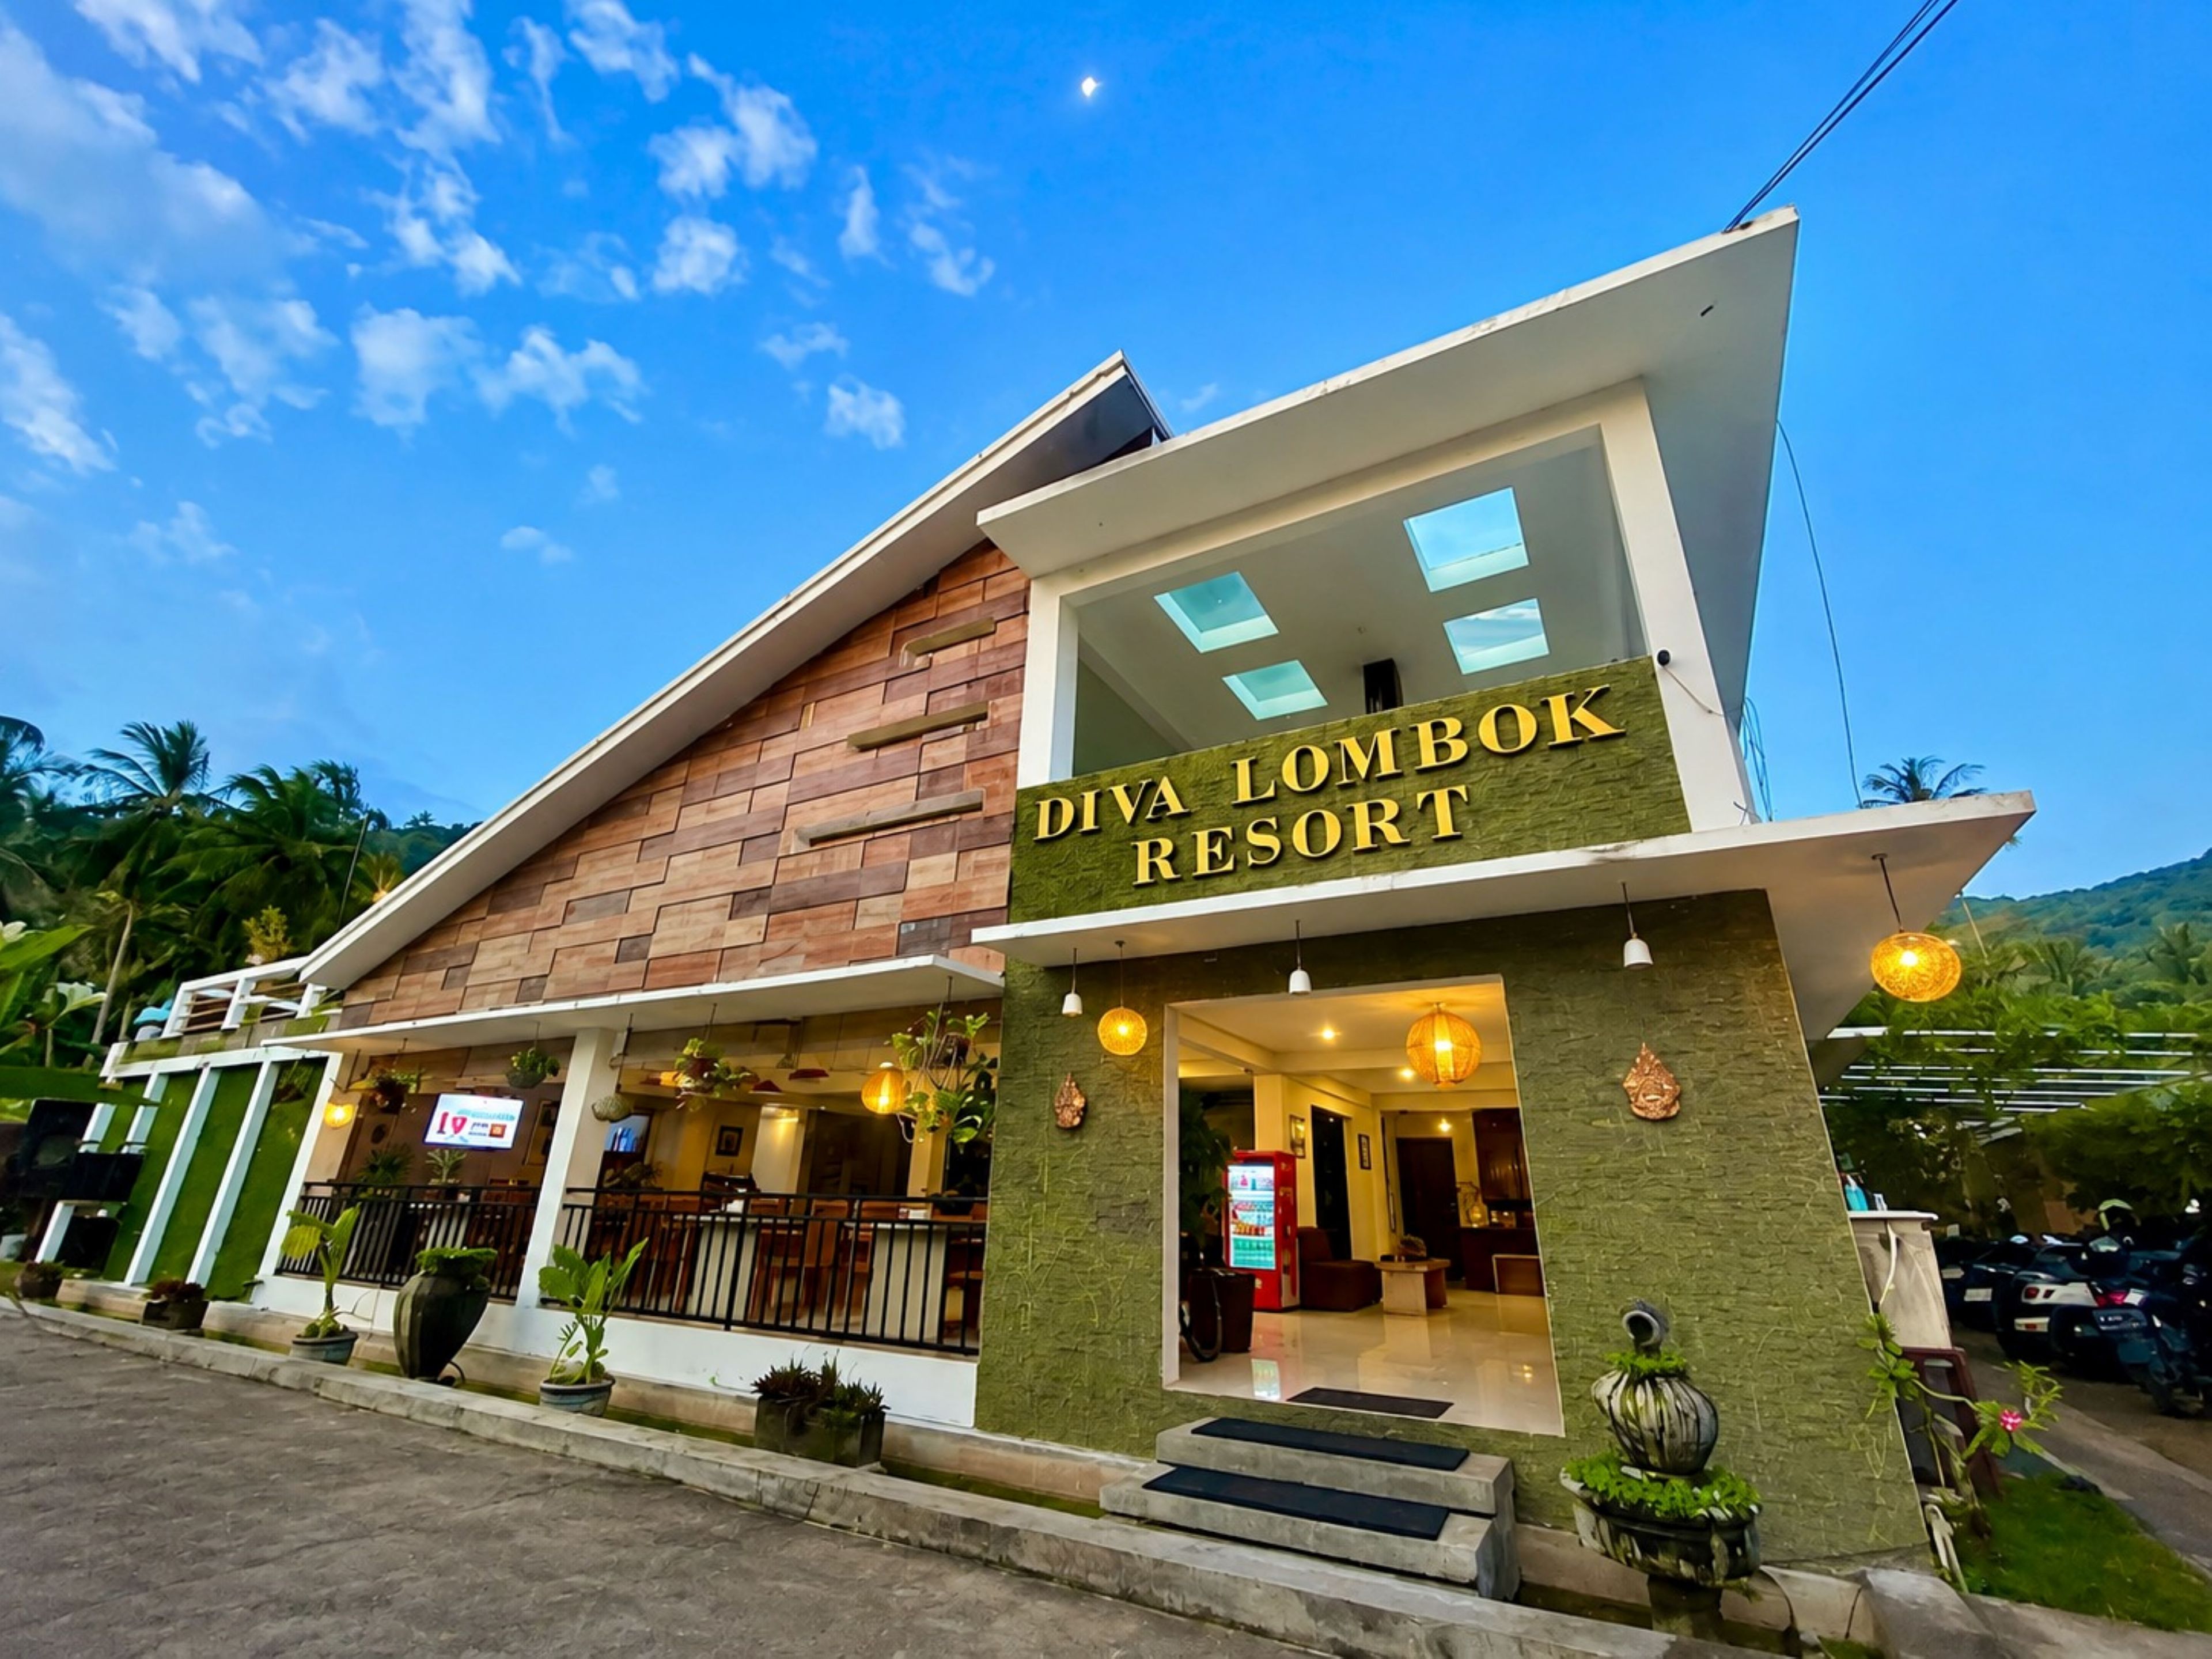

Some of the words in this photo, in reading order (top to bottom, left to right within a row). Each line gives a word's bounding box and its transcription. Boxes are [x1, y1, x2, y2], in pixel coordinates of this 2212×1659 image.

[1034, 776, 1191, 841] DIVA
[1231, 684, 1626, 804] LOMBOK
[1131, 785, 1468, 886] RESORT
